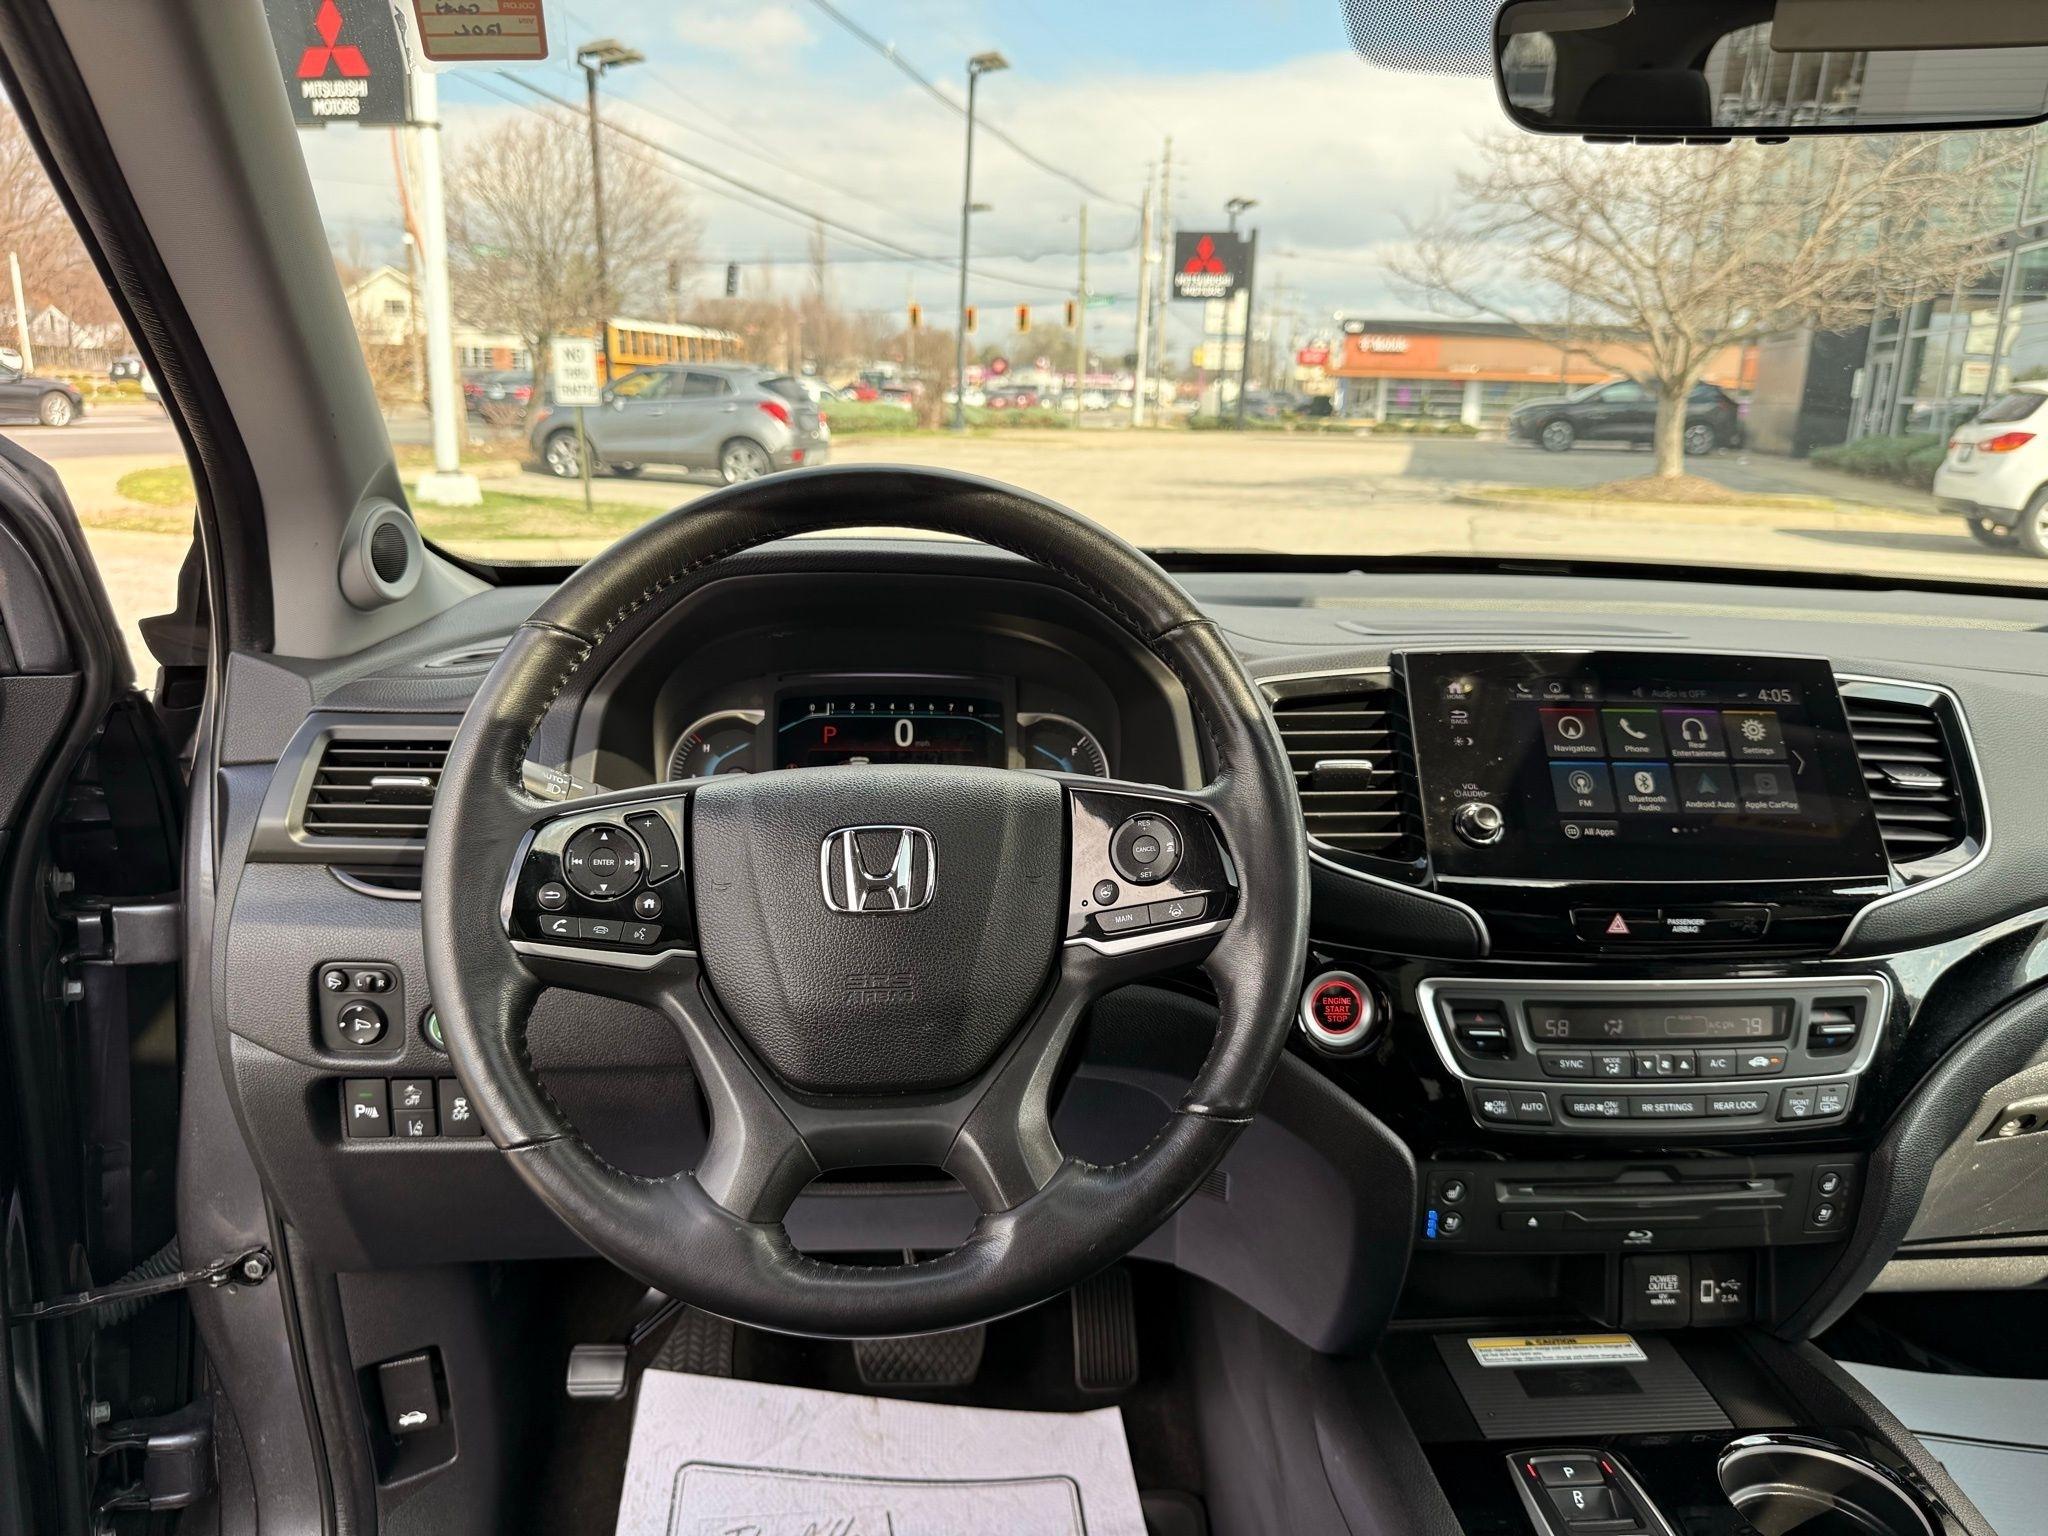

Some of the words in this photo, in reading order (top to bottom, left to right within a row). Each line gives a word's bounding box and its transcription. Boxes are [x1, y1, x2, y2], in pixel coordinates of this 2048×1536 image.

[302, 79, 368, 98] MITSUBISHI
[312, 98, 360, 115] MOTORS
[1757, 689, 1793, 702] 4:05
[850, 703, 856, 711] 2
[869, 703, 876, 711] 3
[889, 703, 896, 711] 4
[909, 703, 915, 711] 5
[929, 703, 935, 711] 6
[949, 703, 955, 711] 7
[823, 726, 838, 744] P
[894, 719, 914, 747] 0
[703, 744, 711, 753] H
[1071, 747, 1078, 757] F
[1554, 744, 1596, 754] Navigation
[1624, 745, 1650, 753] Phone
[1743, 747, 1775, 755] Settings
[1672, 749, 1727, 758] Entertainment
[1462, 790, 1487, 798] AUDIO
[1628, 795, 1667, 803] Bluetooth
[1578, 800, 1593, 808] FM
[1638, 804, 1661, 812] Audio
[1685, 800, 1716, 808] Android
[1717, 801, 1736, 809] Auto
[1745, 801, 1768, 810] Apple
[1768, 801, 1799, 810] CarPlay
[1584, 828, 1594, 836] All
[1595, 828, 1616, 838] Apps
[593, 858, 615, 867] ENTER
[1114, 913, 1133, 923] MAIN
[1666, 918, 1706, 926] PASSENGER
[1671, 925, 1699, 933] AIRBAG
[357, 979, 363, 987] L
[378, 979, 385, 987] R
[1322, 997, 1351, 1005] ENGINE
[1325, 1005, 1350, 1013] START
[1327, 1015, 1348, 1023] STOP
[1545, 1019, 1569, 1037] 58
[1740, 1017, 1762, 1035] 79
[1559, 1059, 1584, 1068] SYNC
[1710, 1059, 1726, 1068] A/C
[404, 1098, 420, 1106] OFF
[1521, 1102, 1543, 1111] AUTO
[1713, 1101, 1733, 1110] REAR
[1736, 1100, 1758, 1109] LOCK
[1789, 1098, 1810, 1106] FRONT
[1493, 1106, 1507, 1115] OFF
[1573, 1103, 1596, 1112] REAR
[1604, 1107, 1619, 1116] OFF
[1641, 1103, 1653, 1112] RR
[1654, 1103, 1693, 1112] SETTINGS
[452, 1112, 470, 1121] OFF
[1649, 1274, 1679, 1282] POWER
[1648, 1282, 1679, 1290] OUTLET
[1536, 1337, 1578, 1346] CAUTION
[1563, 1466, 1574, 1478] P
[1572, 1490, 1584, 1504] R
